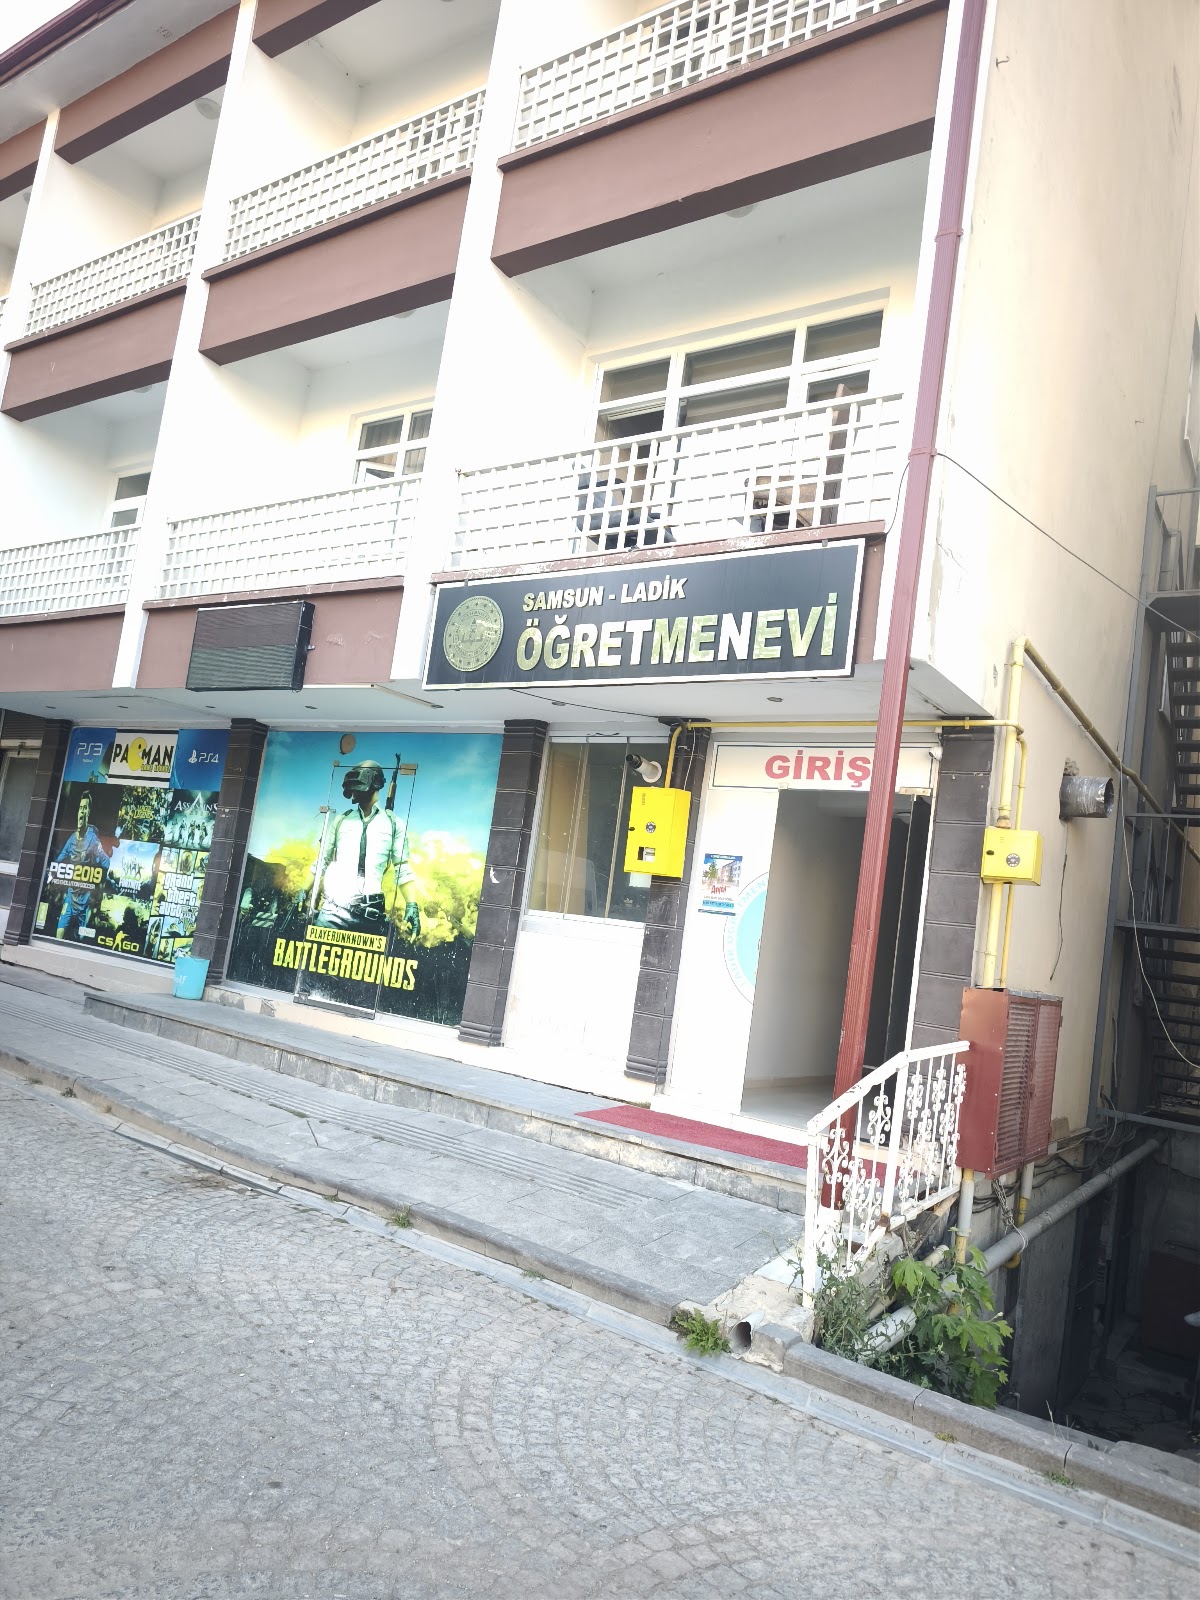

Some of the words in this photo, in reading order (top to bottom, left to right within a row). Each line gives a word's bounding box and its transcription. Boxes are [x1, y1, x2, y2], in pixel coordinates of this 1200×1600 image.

[523, 586, 605, 612] SAMSUN
[620, 575, 689, 604] LADİK
[516, 592, 838, 671] ÖĞRETMENEVİ
[77, 742, 103, 756] PS3
[198, 752, 219, 763] PS4
[765, 750, 871, 788] GİRİŞ
[309, 927, 383, 949] PLAYERUNKNOWN'S
[273, 938, 418, 991] BATTLEGROUNDS
